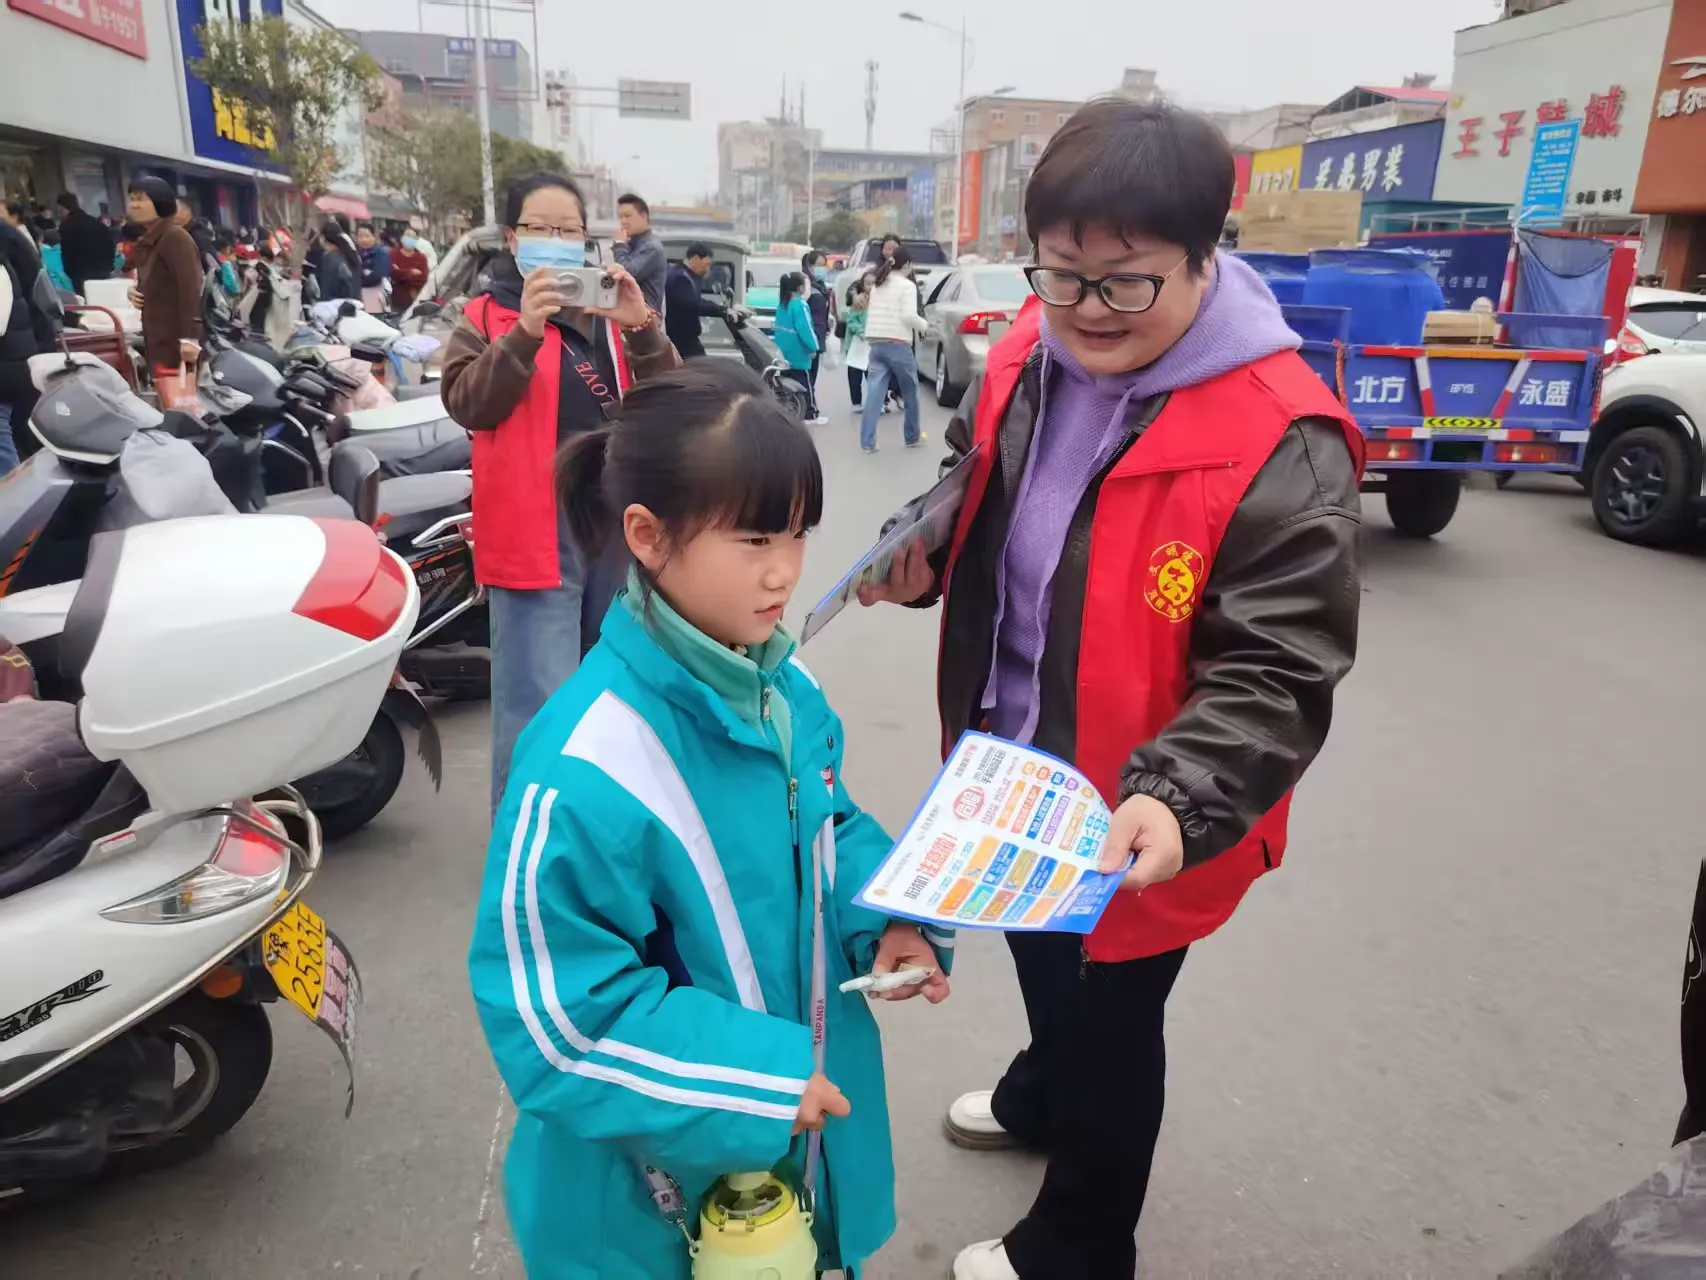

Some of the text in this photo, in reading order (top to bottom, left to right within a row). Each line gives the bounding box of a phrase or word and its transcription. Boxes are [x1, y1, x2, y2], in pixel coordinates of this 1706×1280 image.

[575, 361, 617, 406] LOVE
[1352, 375, 1407, 404] 北方
[1519, 378, 1572, 407] 永盛
[813, 998, 825, 1047] SANPANDA
